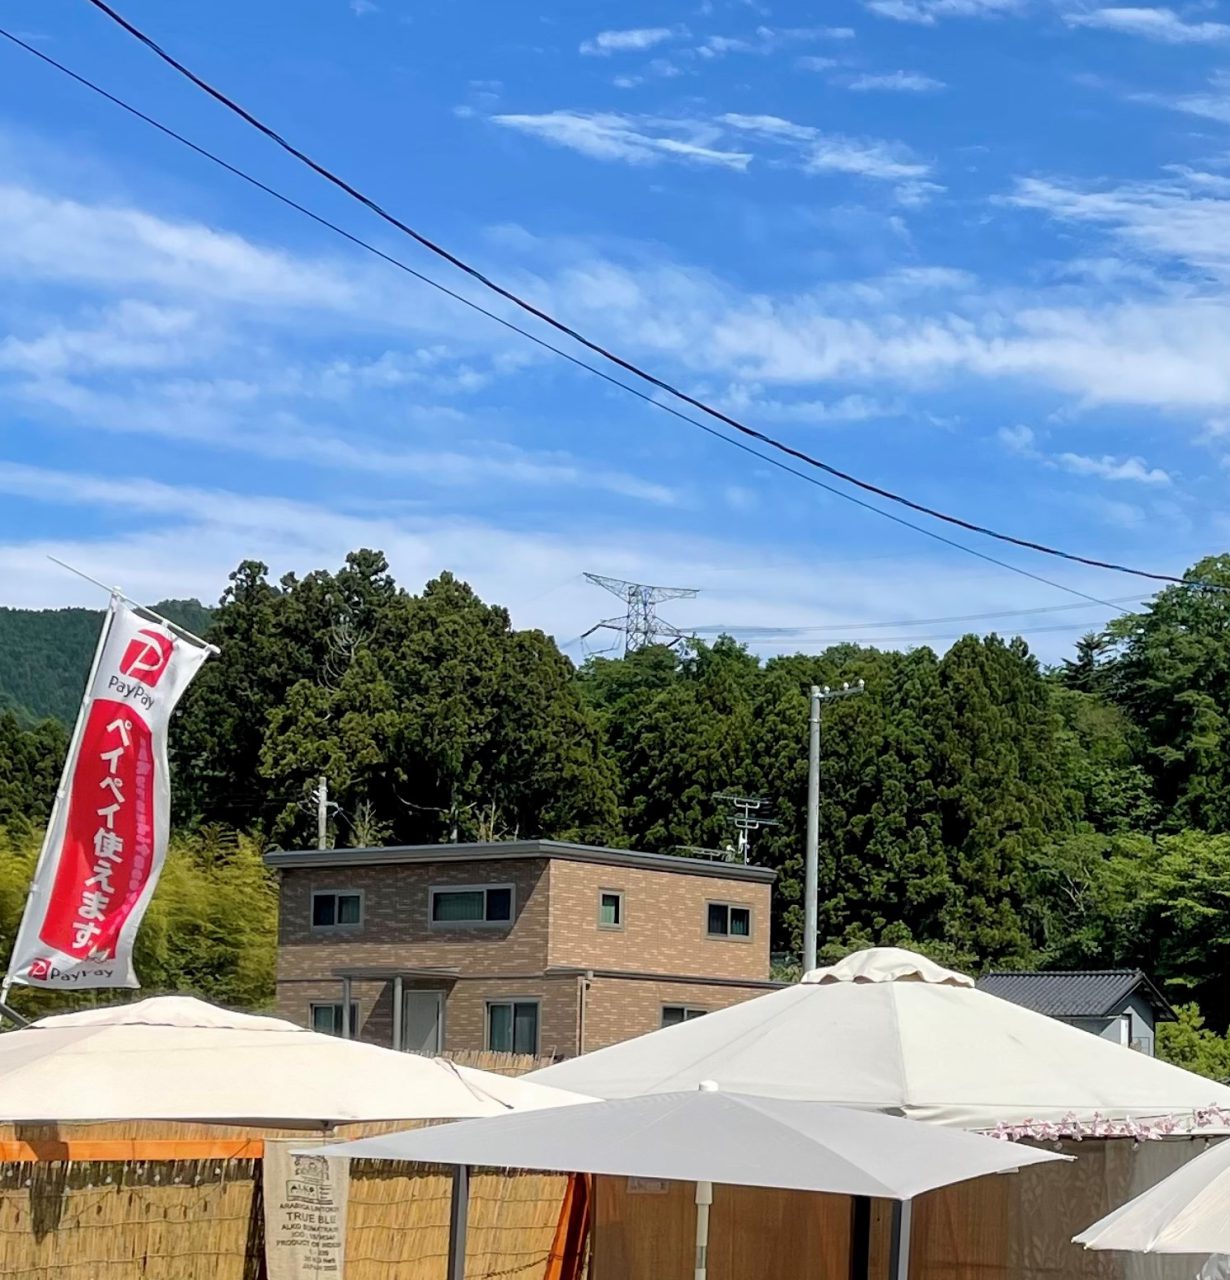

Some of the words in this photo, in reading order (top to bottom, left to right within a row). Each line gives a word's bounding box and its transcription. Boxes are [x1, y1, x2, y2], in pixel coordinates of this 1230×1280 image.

[108, 675, 155, 711] PayPay
[71, 717, 134, 949] ペイペイ使えます
[286, 1212, 316, 1224] TRUE
